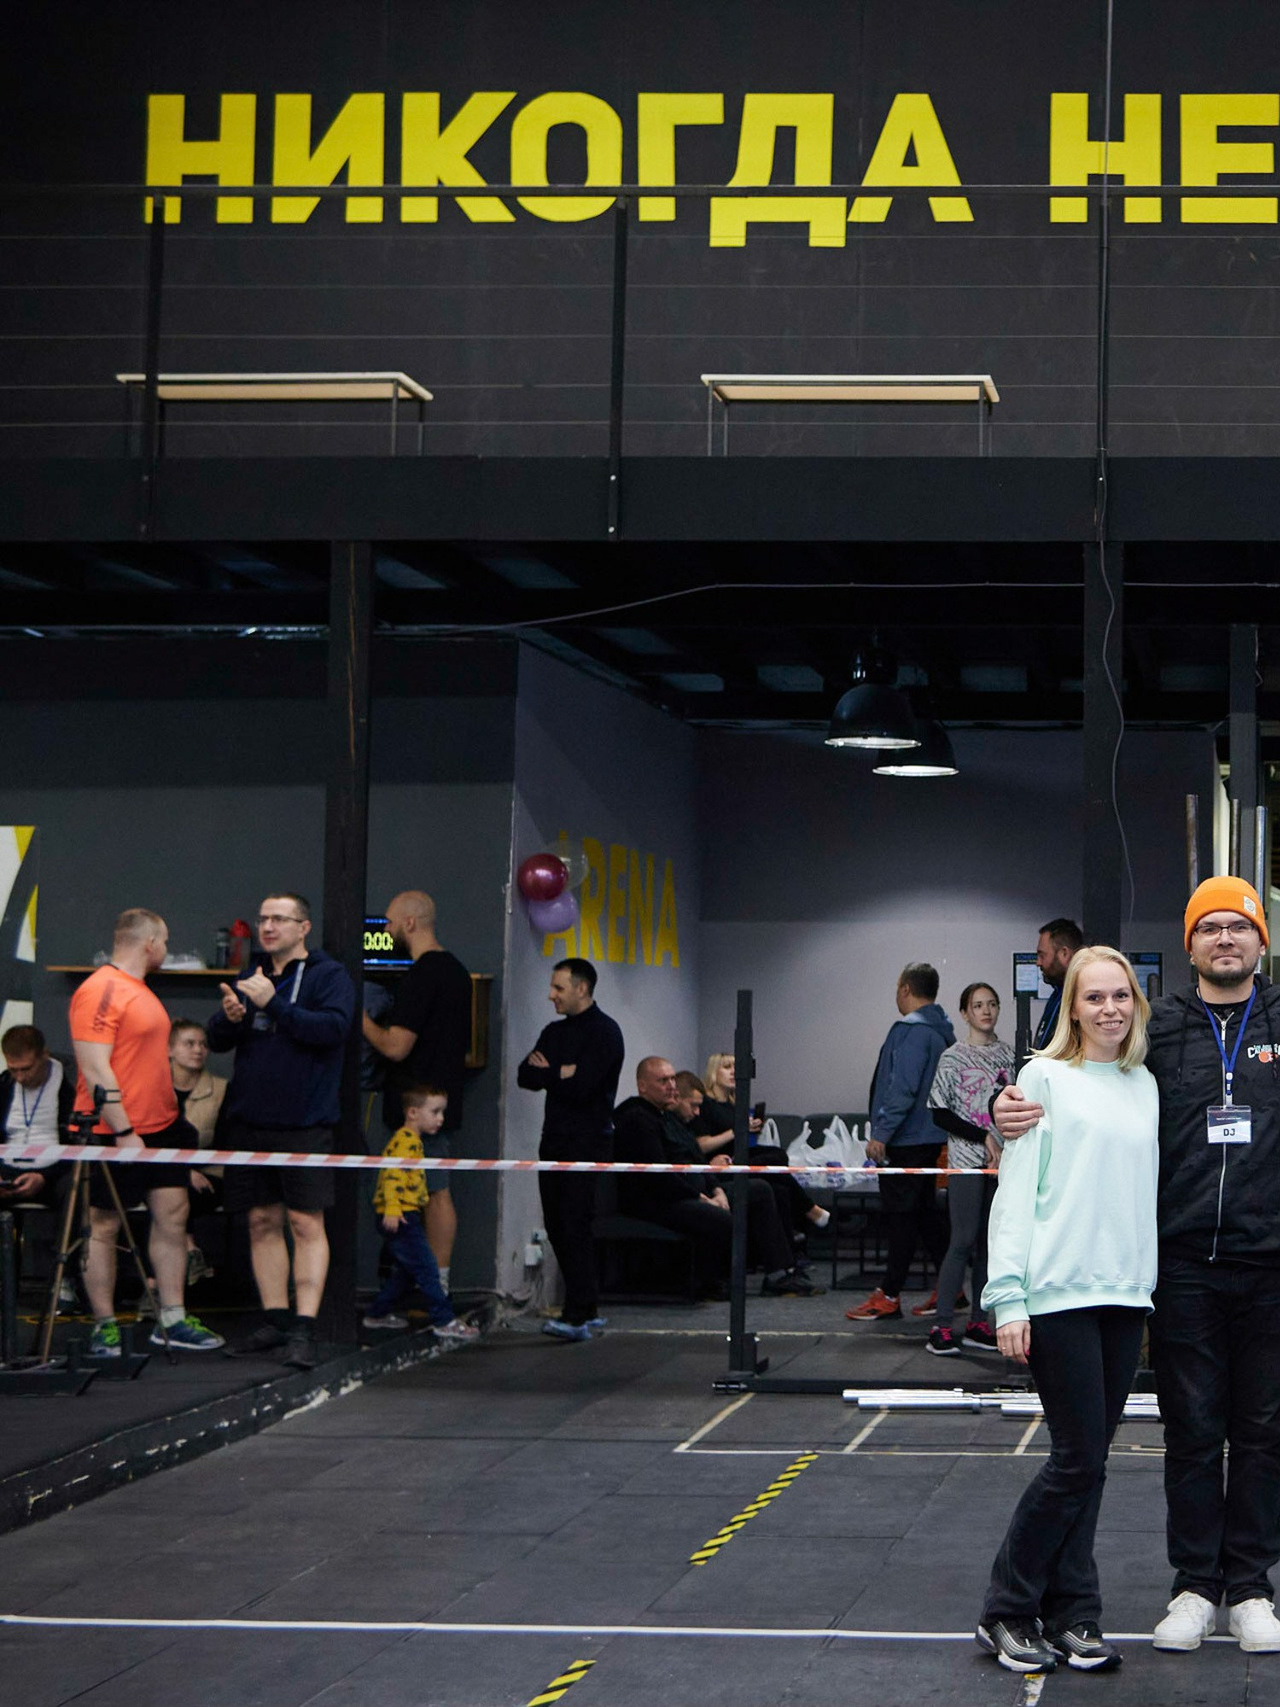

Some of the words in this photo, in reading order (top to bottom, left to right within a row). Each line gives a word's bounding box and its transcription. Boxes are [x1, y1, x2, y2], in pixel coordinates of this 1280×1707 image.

[145, 92, 973, 247] НИКОГДА
[1050, 93, 1280, 223] НЕ
[1223, 1128, 1236, 1137] DJ
